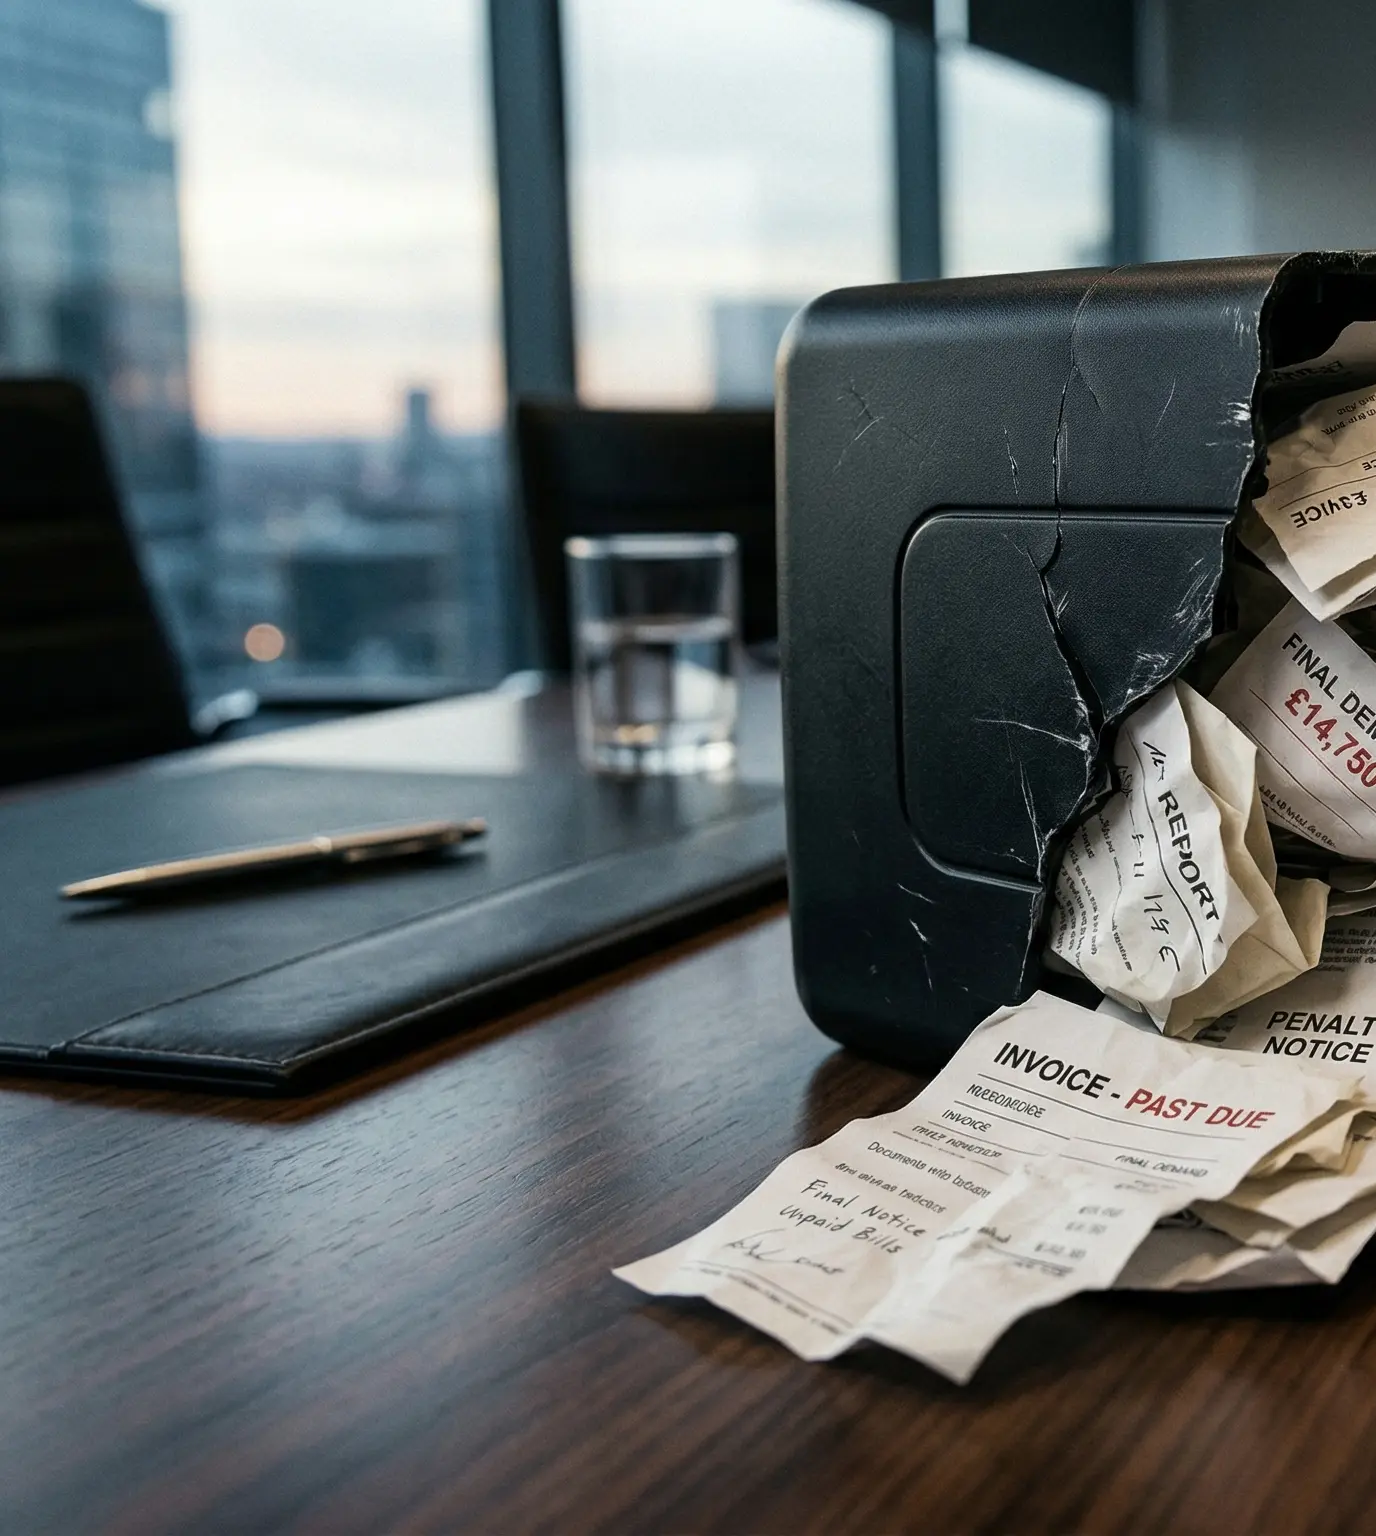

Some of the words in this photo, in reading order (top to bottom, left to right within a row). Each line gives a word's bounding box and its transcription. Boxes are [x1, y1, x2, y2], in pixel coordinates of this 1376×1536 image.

[1281, 632, 1341, 699] FINAL
[1158, 790, 1220, 922] REPORT
[1262, 1036, 1374, 1064] NOTICE
[993, 1042, 1111, 1100] INVOICE
[1124, 1088, 1209, 1122] PAST
[1205, 1105, 1276, 1130] DUE
[941, 1109, 992, 1133] INVOICE
[801, 1178, 860, 1210] Final
[861, 1203, 929, 1238] Notice
[852, 1224, 903, 1255] Bills
